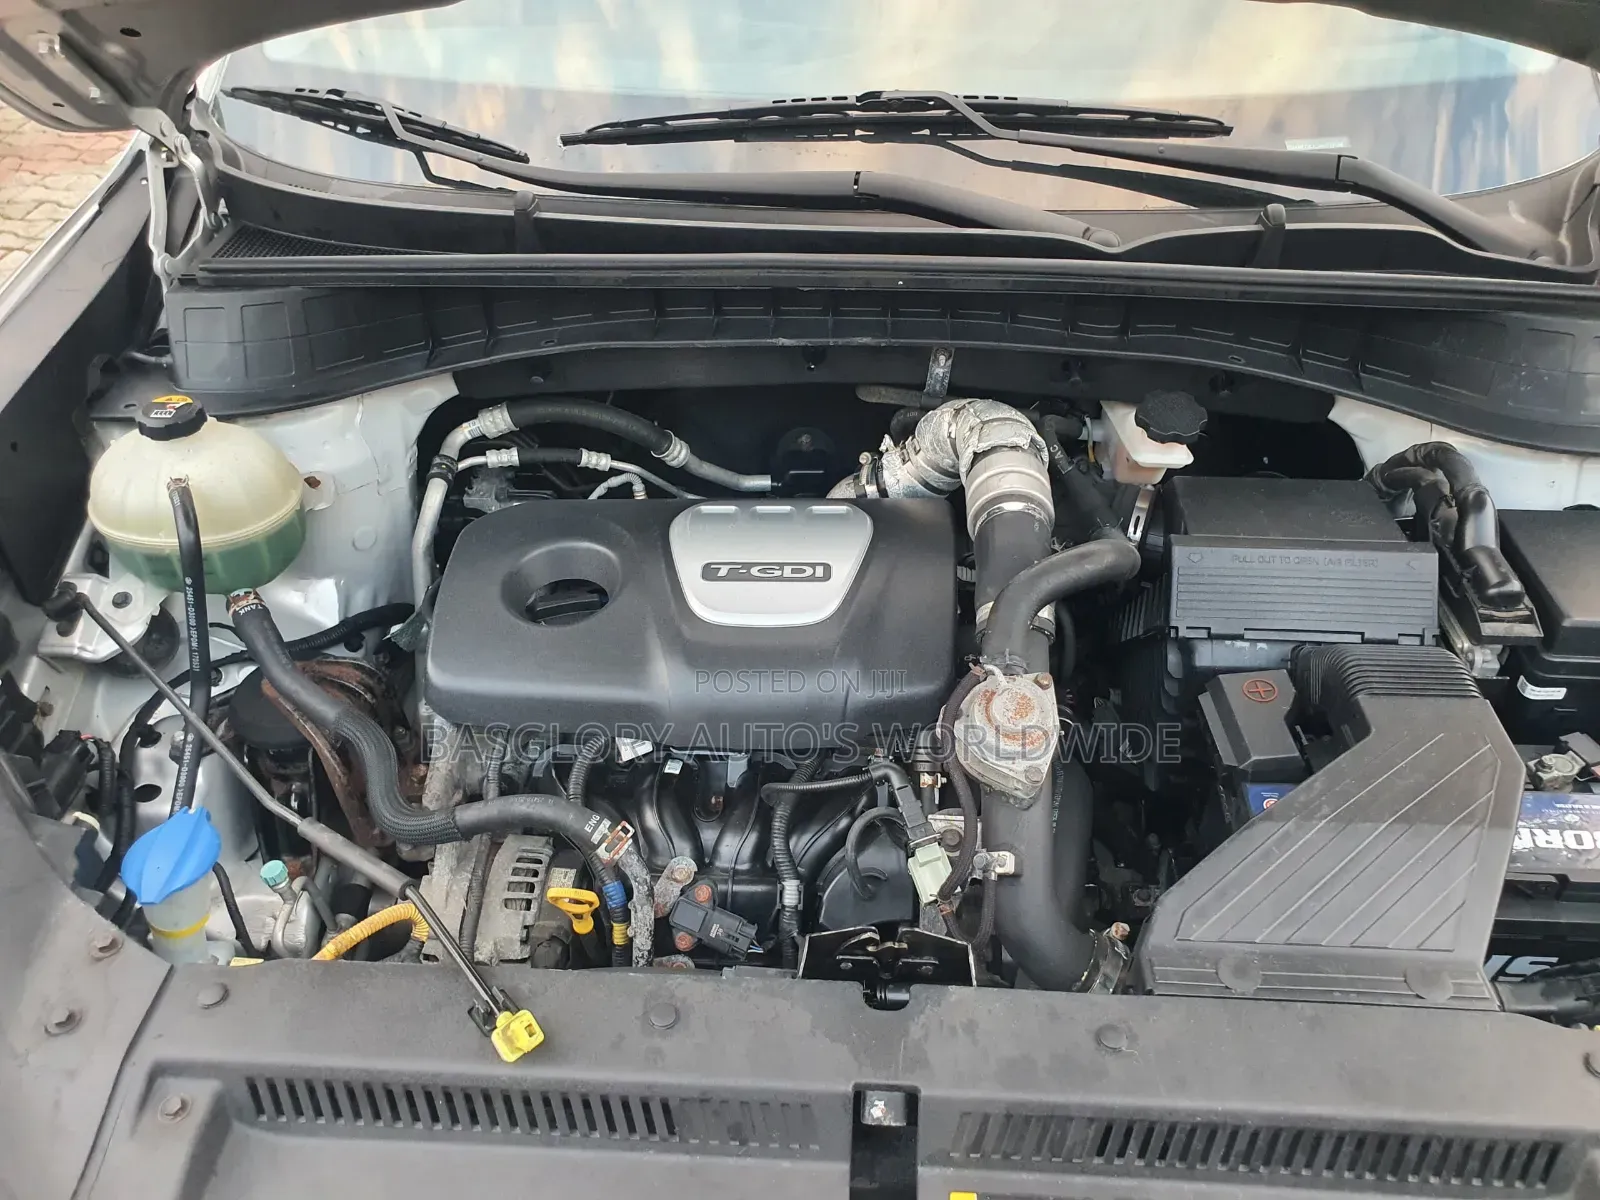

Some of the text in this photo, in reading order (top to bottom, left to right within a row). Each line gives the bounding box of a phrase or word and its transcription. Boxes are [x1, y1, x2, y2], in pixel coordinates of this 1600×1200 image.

[1257, 555, 1277, 565] OUT
[1280, 556, 1292, 565] TO
[710, 564, 824, 578] T-GDI
[238, 603, 264, 616] TANK
[584, 813, 601, 834] ENG
